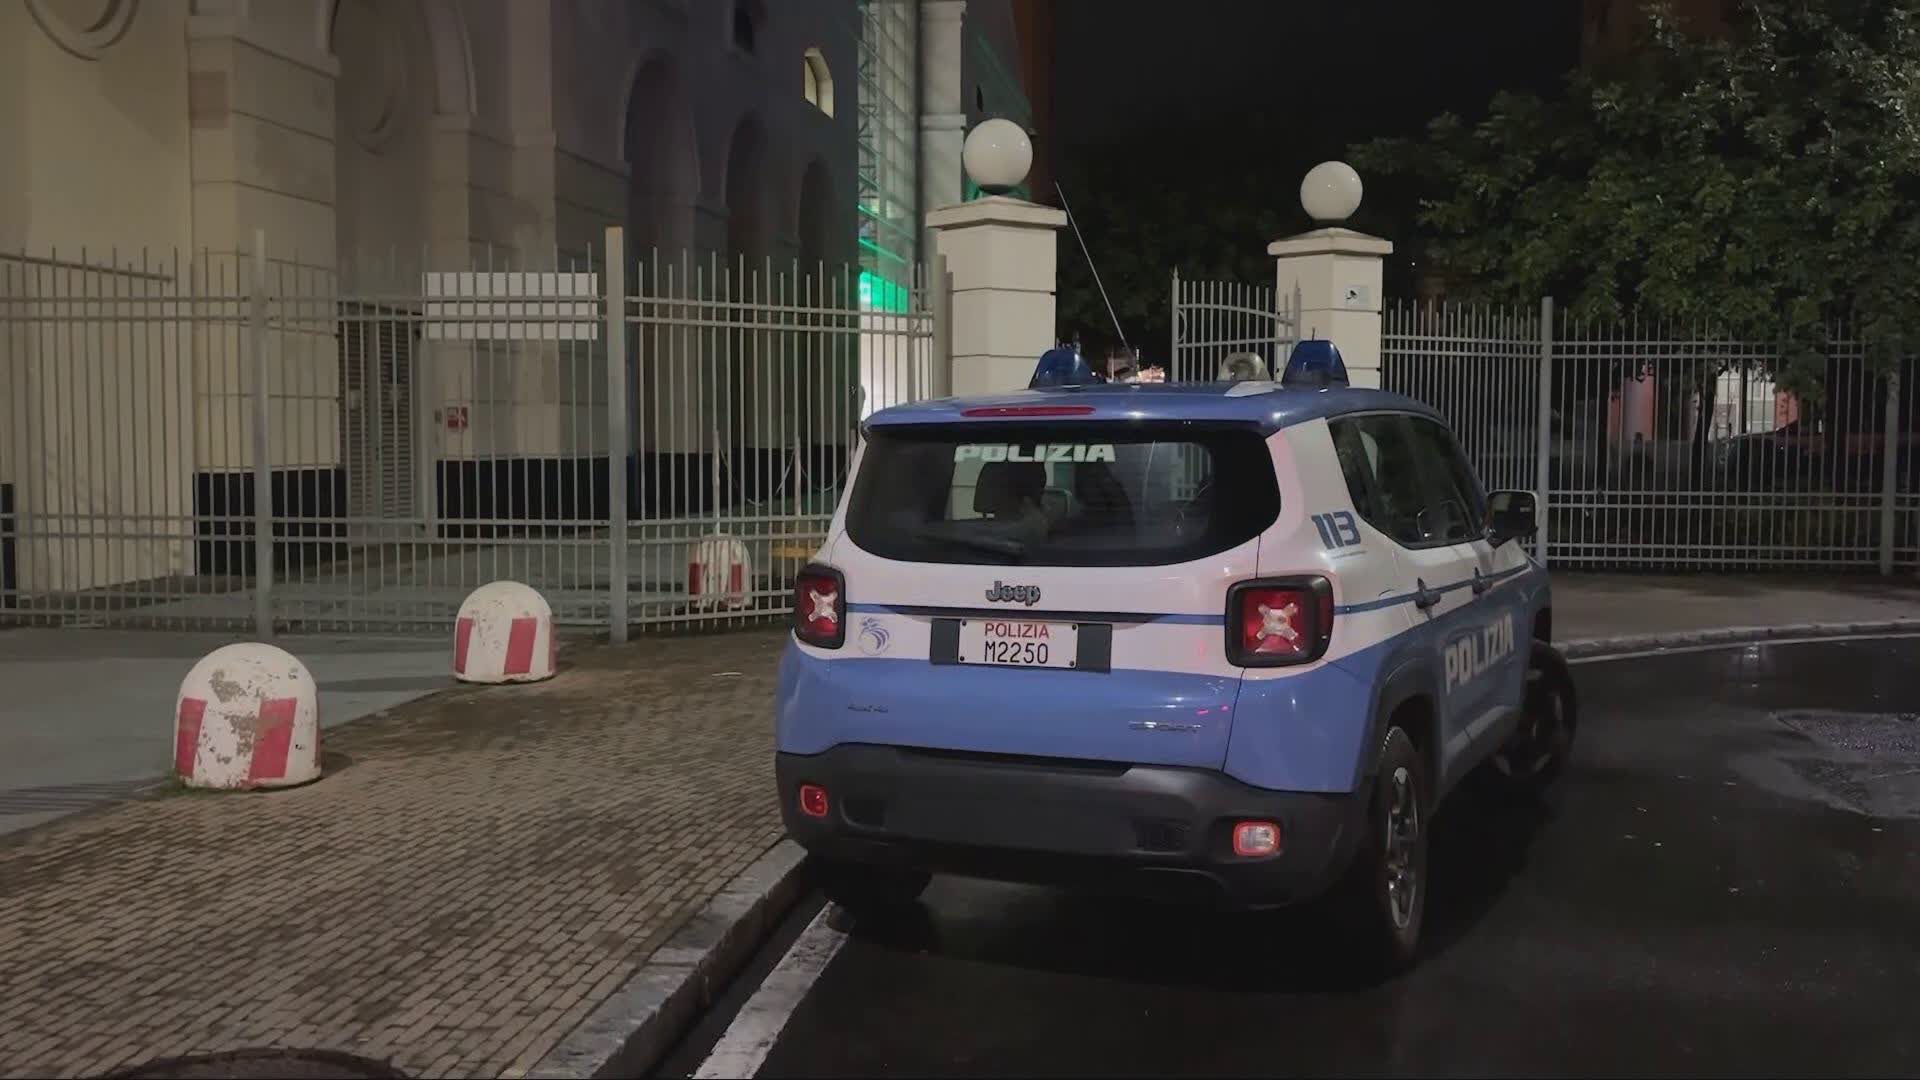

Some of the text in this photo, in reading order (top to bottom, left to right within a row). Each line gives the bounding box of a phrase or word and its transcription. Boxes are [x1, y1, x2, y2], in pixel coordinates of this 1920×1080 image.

[954, 443, 1115, 463] POLIZIA
[1311, 511, 1361, 549] 113
[985, 580, 1041, 606] Jeep
[984, 623, 1049, 638] POLIZIA
[984, 641, 1049, 664] M2250
[1445, 612, 1515, 695] POLIZIA
